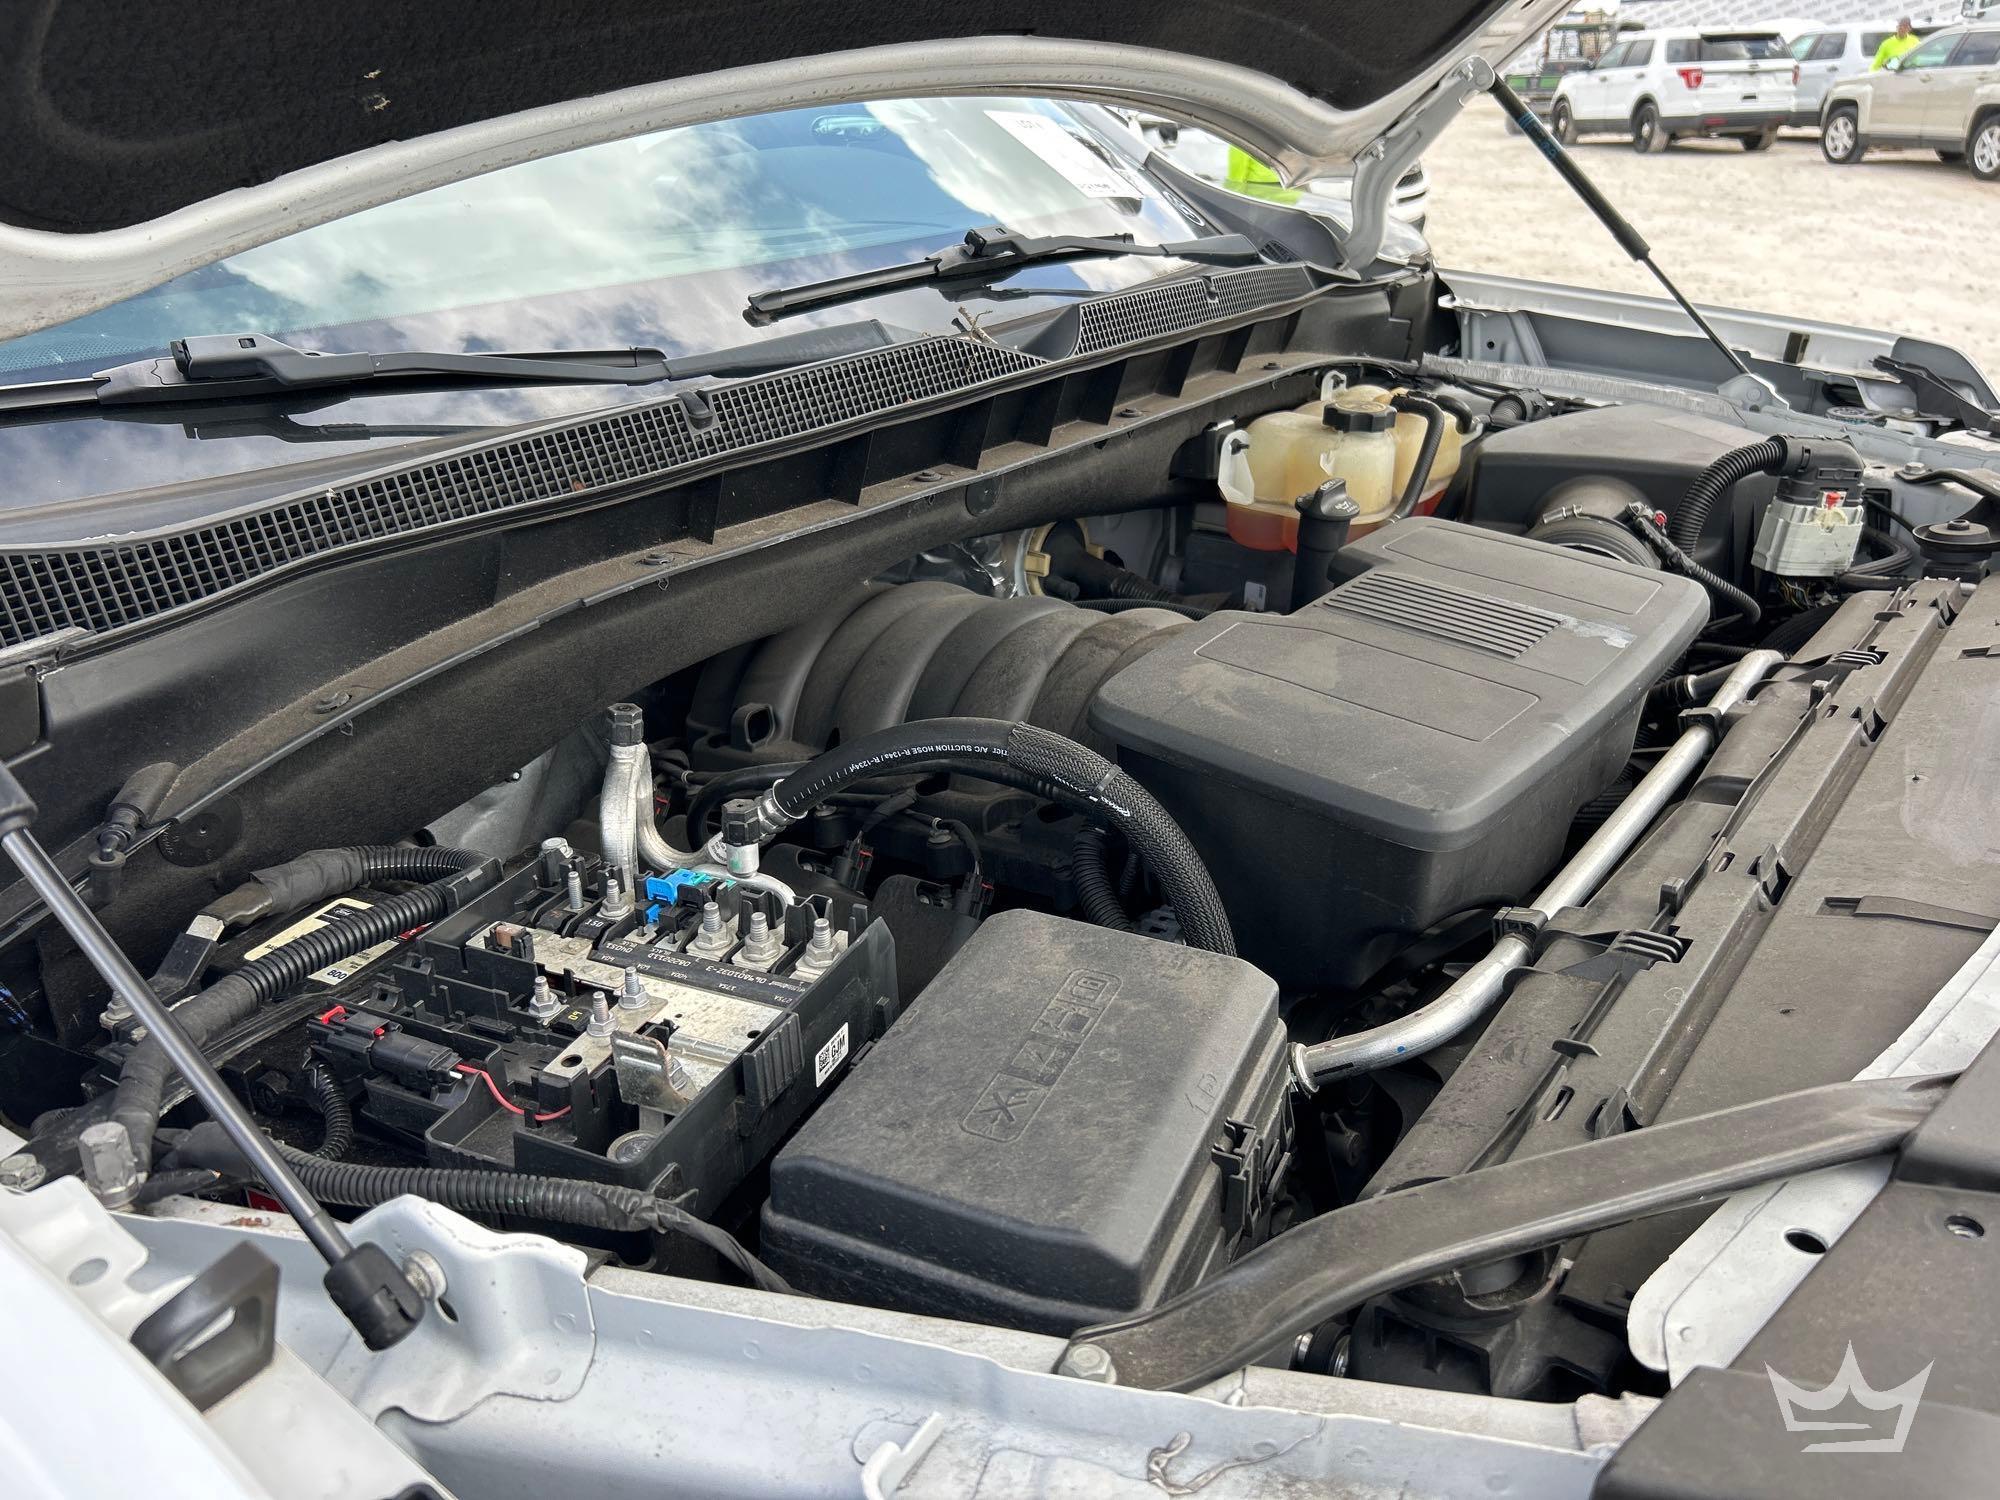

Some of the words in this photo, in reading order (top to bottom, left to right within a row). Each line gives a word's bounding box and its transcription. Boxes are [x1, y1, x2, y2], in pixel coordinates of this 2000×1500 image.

[911, 745, 934, 755] HOSE
[936, 744, 972, 752] SUCTION
[884, 749, 910, 759] R-134a
[848, 756, 880, 773] R-1234yf
[585, 920, 604, 928] 150
[326, 970, 348, 980] 800
[832, 1034, 844, 1058] GJM
